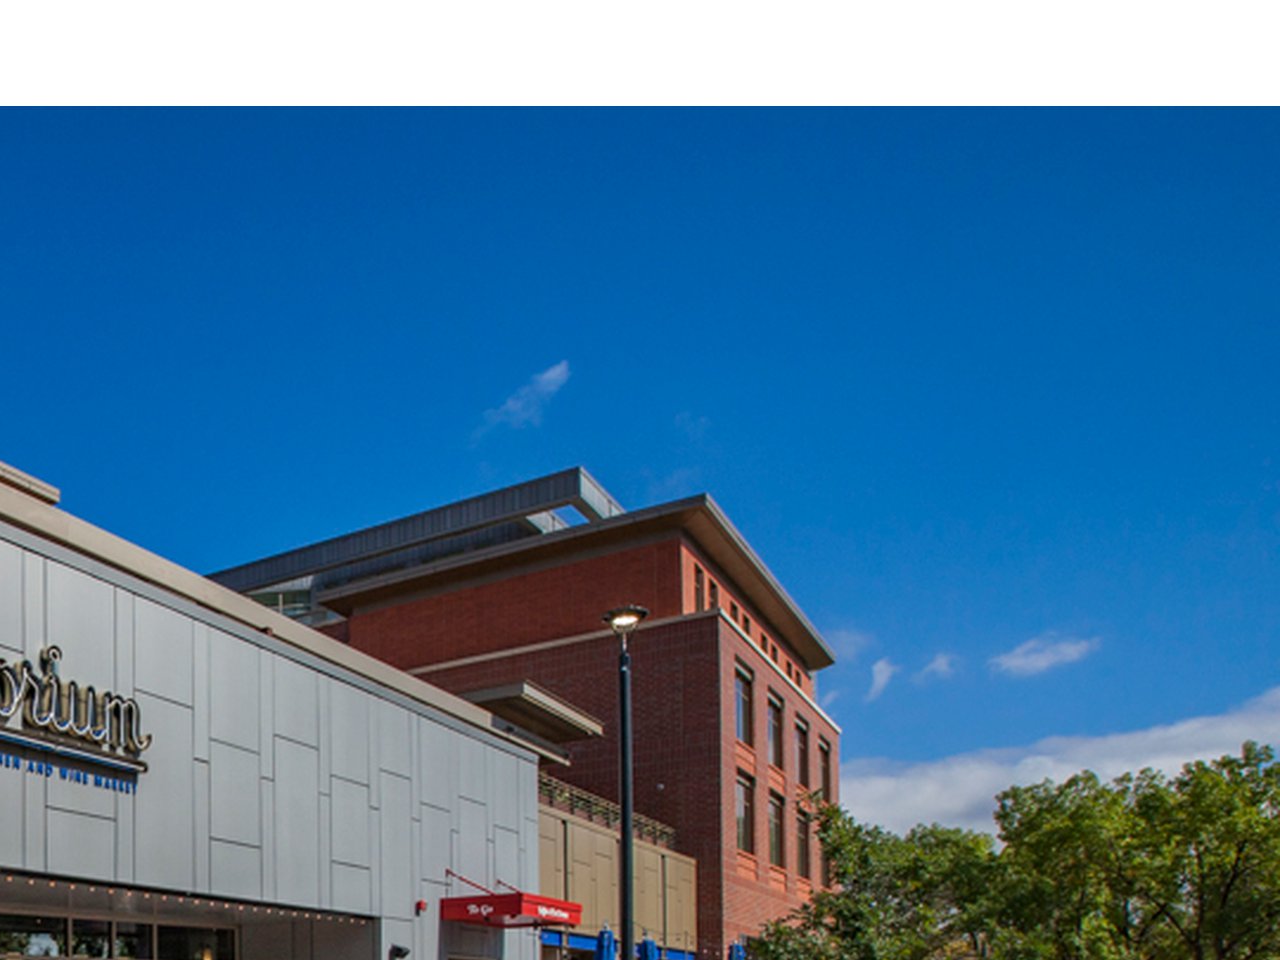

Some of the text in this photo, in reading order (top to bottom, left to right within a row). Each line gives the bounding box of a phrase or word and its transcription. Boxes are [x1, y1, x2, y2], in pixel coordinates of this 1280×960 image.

[26, 760, 54, 778] AND
[59, 767, 89, 786] WINE
[93, 774, 138, 796] MARKET
